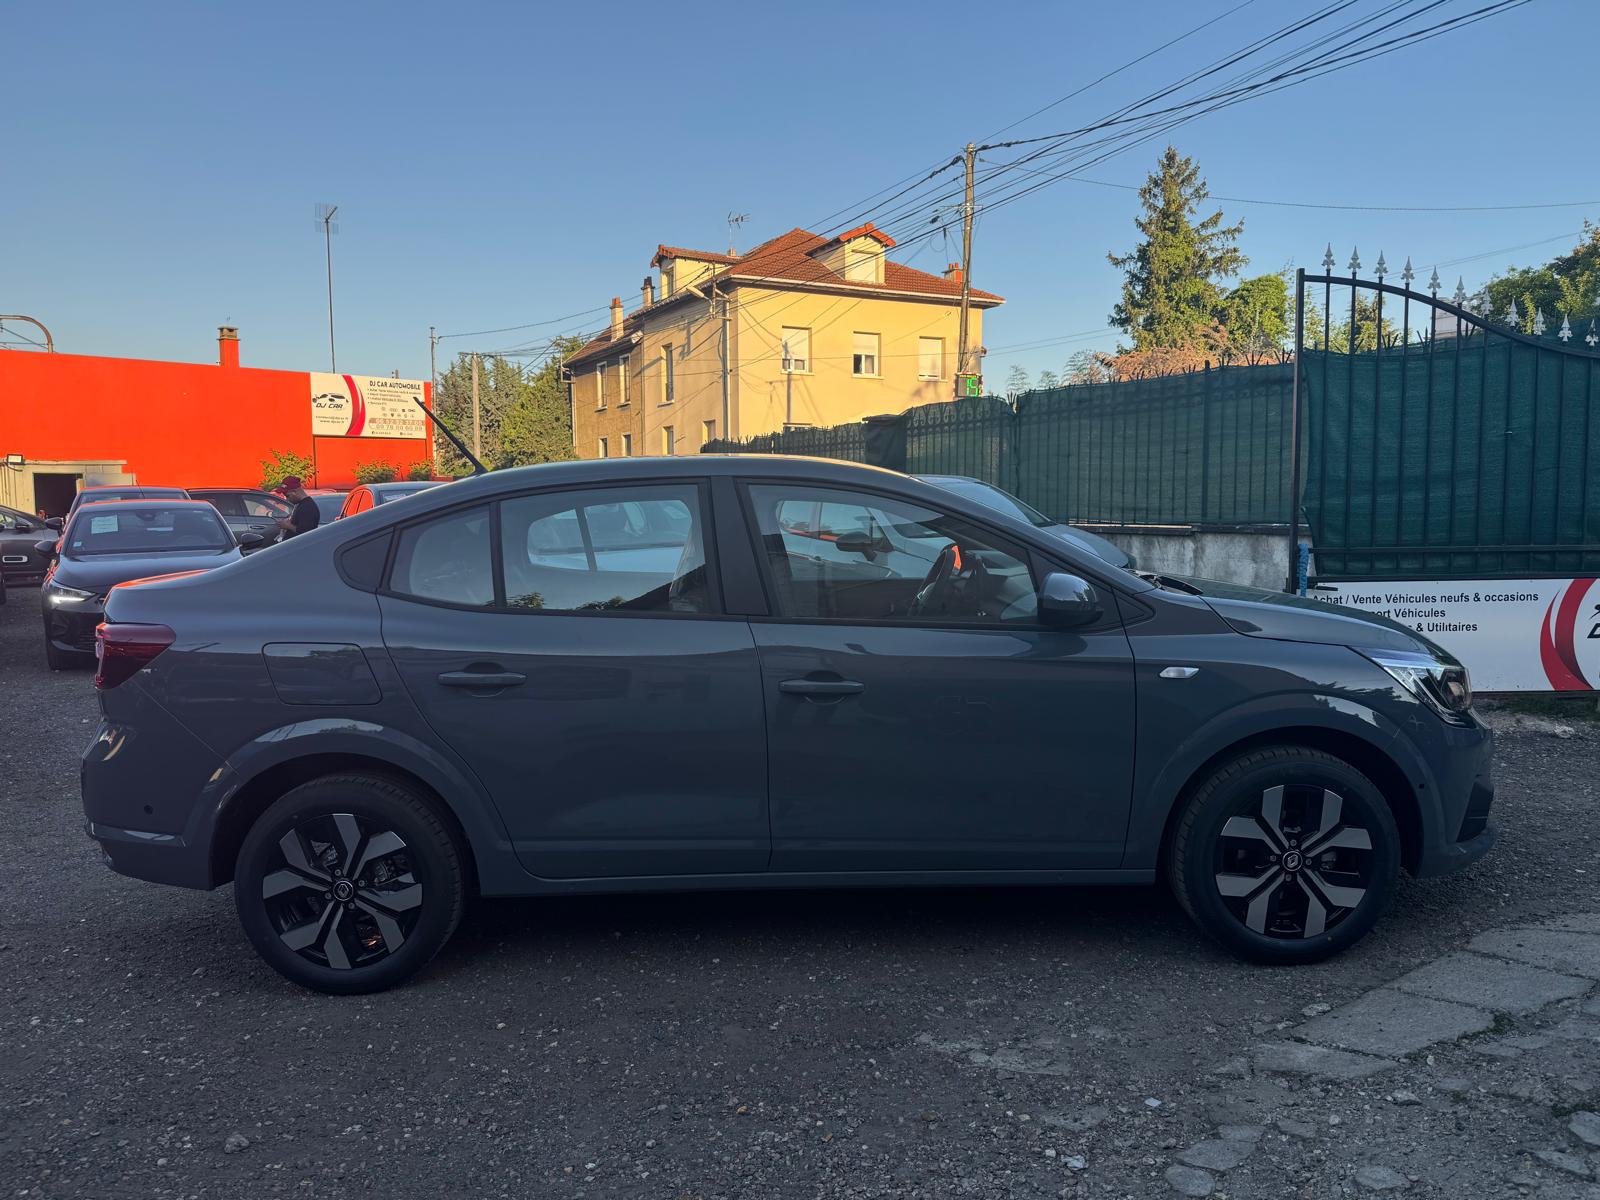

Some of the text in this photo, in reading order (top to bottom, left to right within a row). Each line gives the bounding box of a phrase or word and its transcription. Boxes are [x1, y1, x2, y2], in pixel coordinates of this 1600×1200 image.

[389, 382, 421, 390] AUTOMOBILE
[1352, 594, 1382, 604] Vente
[1385, 593, 1437, 604] Véhicules
[1440, 592, 1470, 603] neufs
[1473, 592, 1481, 602] &
[1484, 591, 1539, 602] occasions
[1394, 608, 1446, 618] Véhicules
[1416, 621, 1478, 632] & Utilitaires
